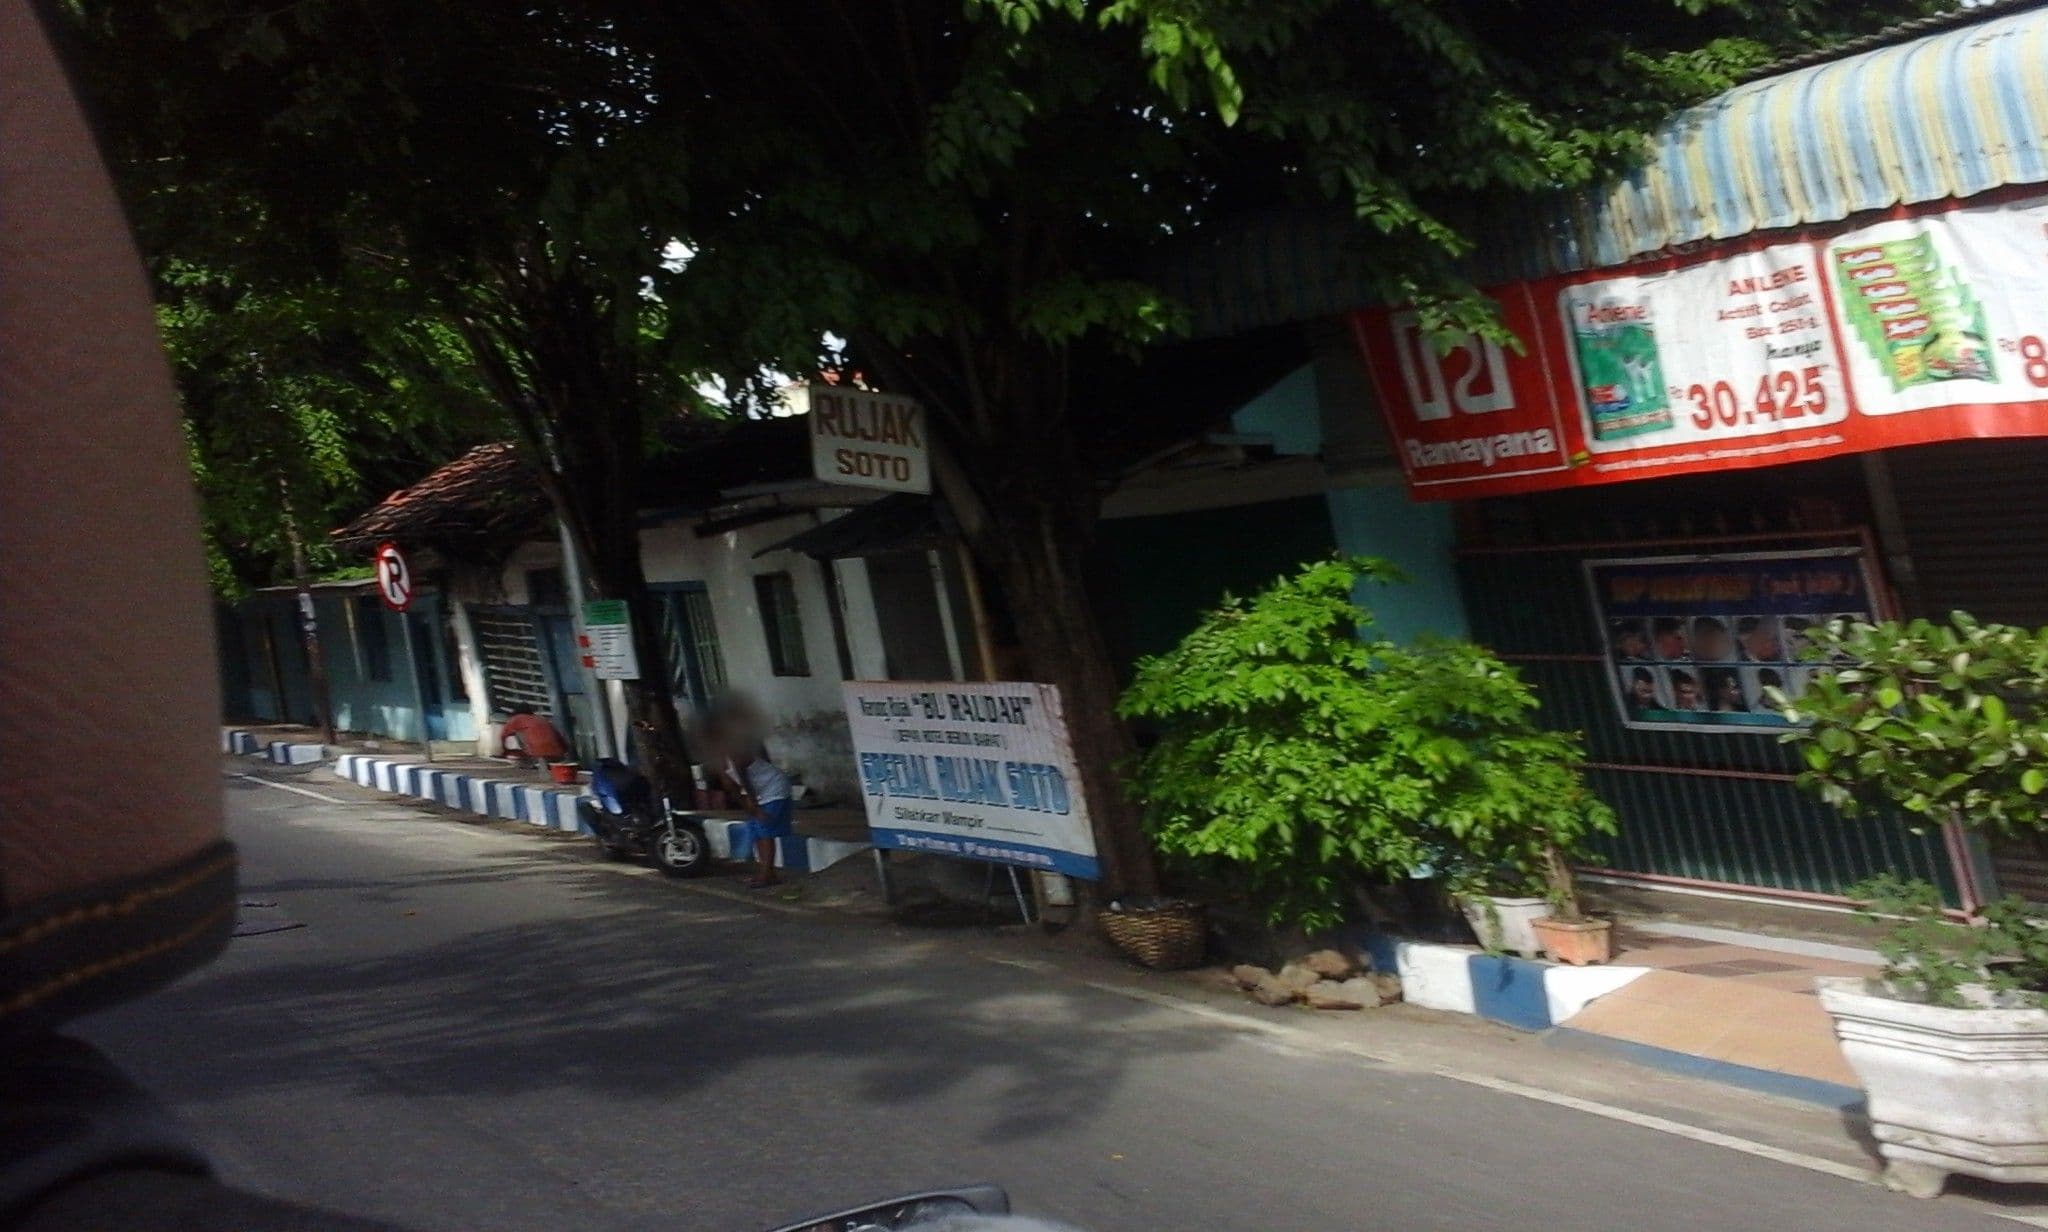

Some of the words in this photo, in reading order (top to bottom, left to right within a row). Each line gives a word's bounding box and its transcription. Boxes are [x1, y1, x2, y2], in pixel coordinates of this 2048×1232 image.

[1729, 265, 1807, 296] ANLENE
[1688, 364, 1829, 431] 30.425
[816, 393, 921, 449] RUJAK
[835, 448, 910, 482] SOTO
[1404, 427, 1558, 468] Ramayana
